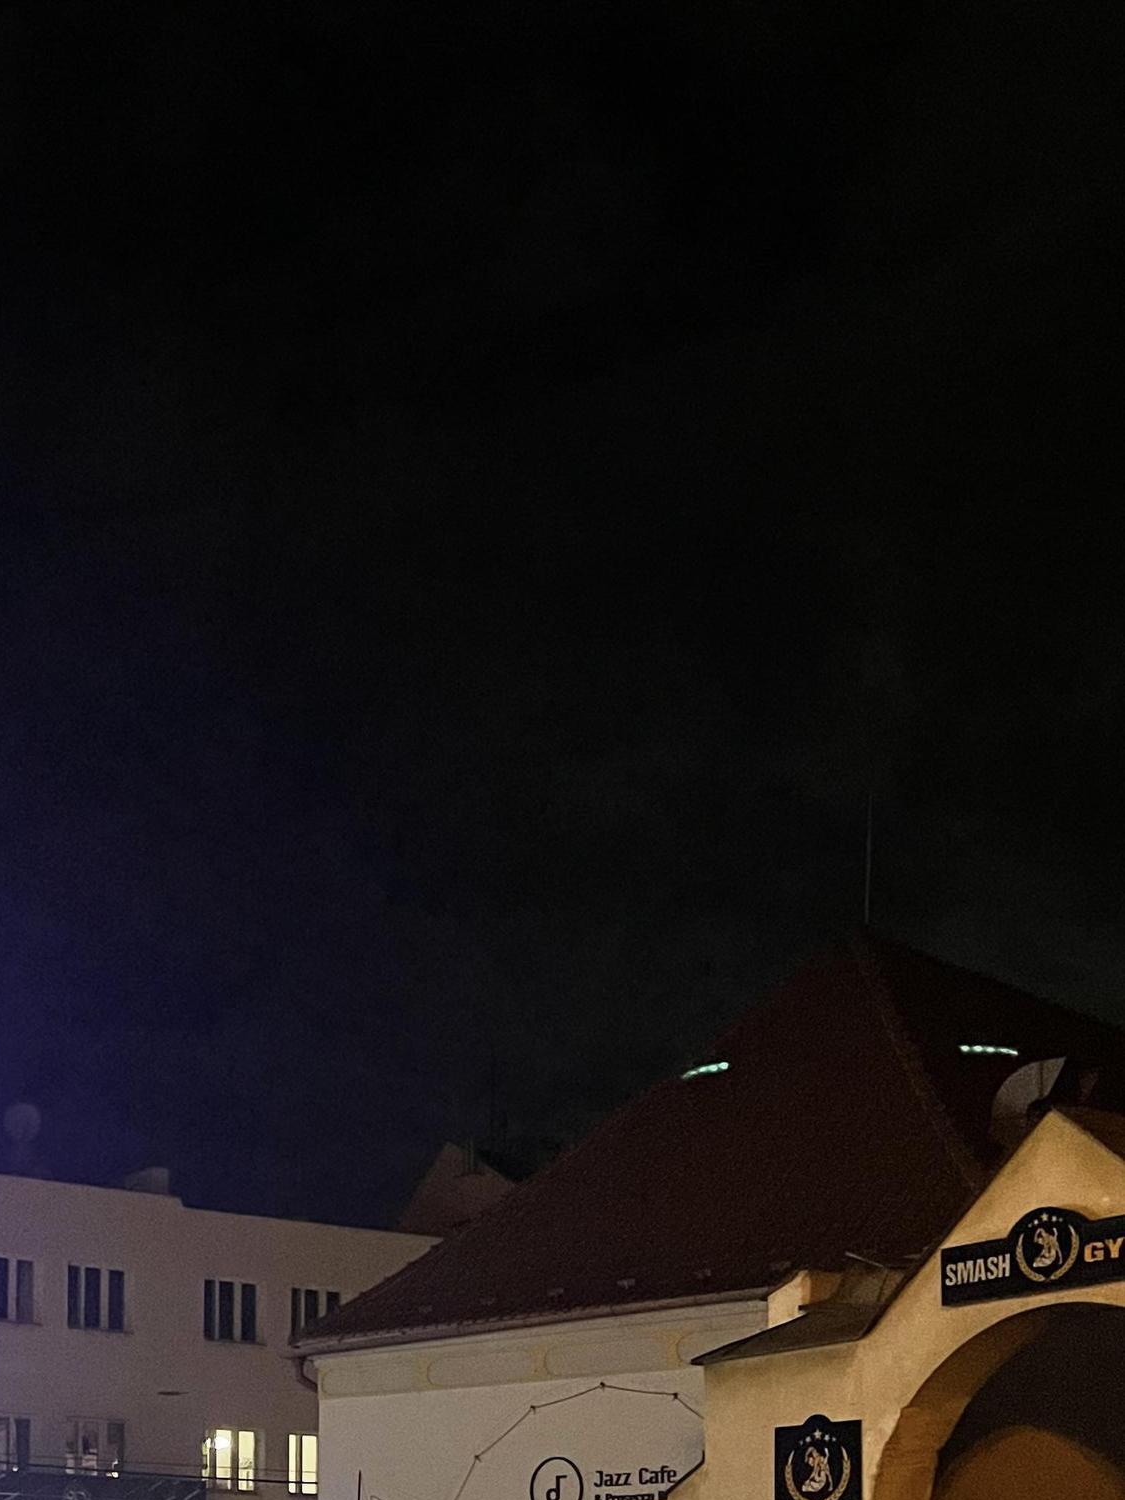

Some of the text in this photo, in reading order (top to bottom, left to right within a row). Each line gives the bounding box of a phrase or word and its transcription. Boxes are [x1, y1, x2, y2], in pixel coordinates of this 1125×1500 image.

[945, 1253, 1011, 1286] SMASH
[593, 1465, 677, 1488] Jazz Cafe
